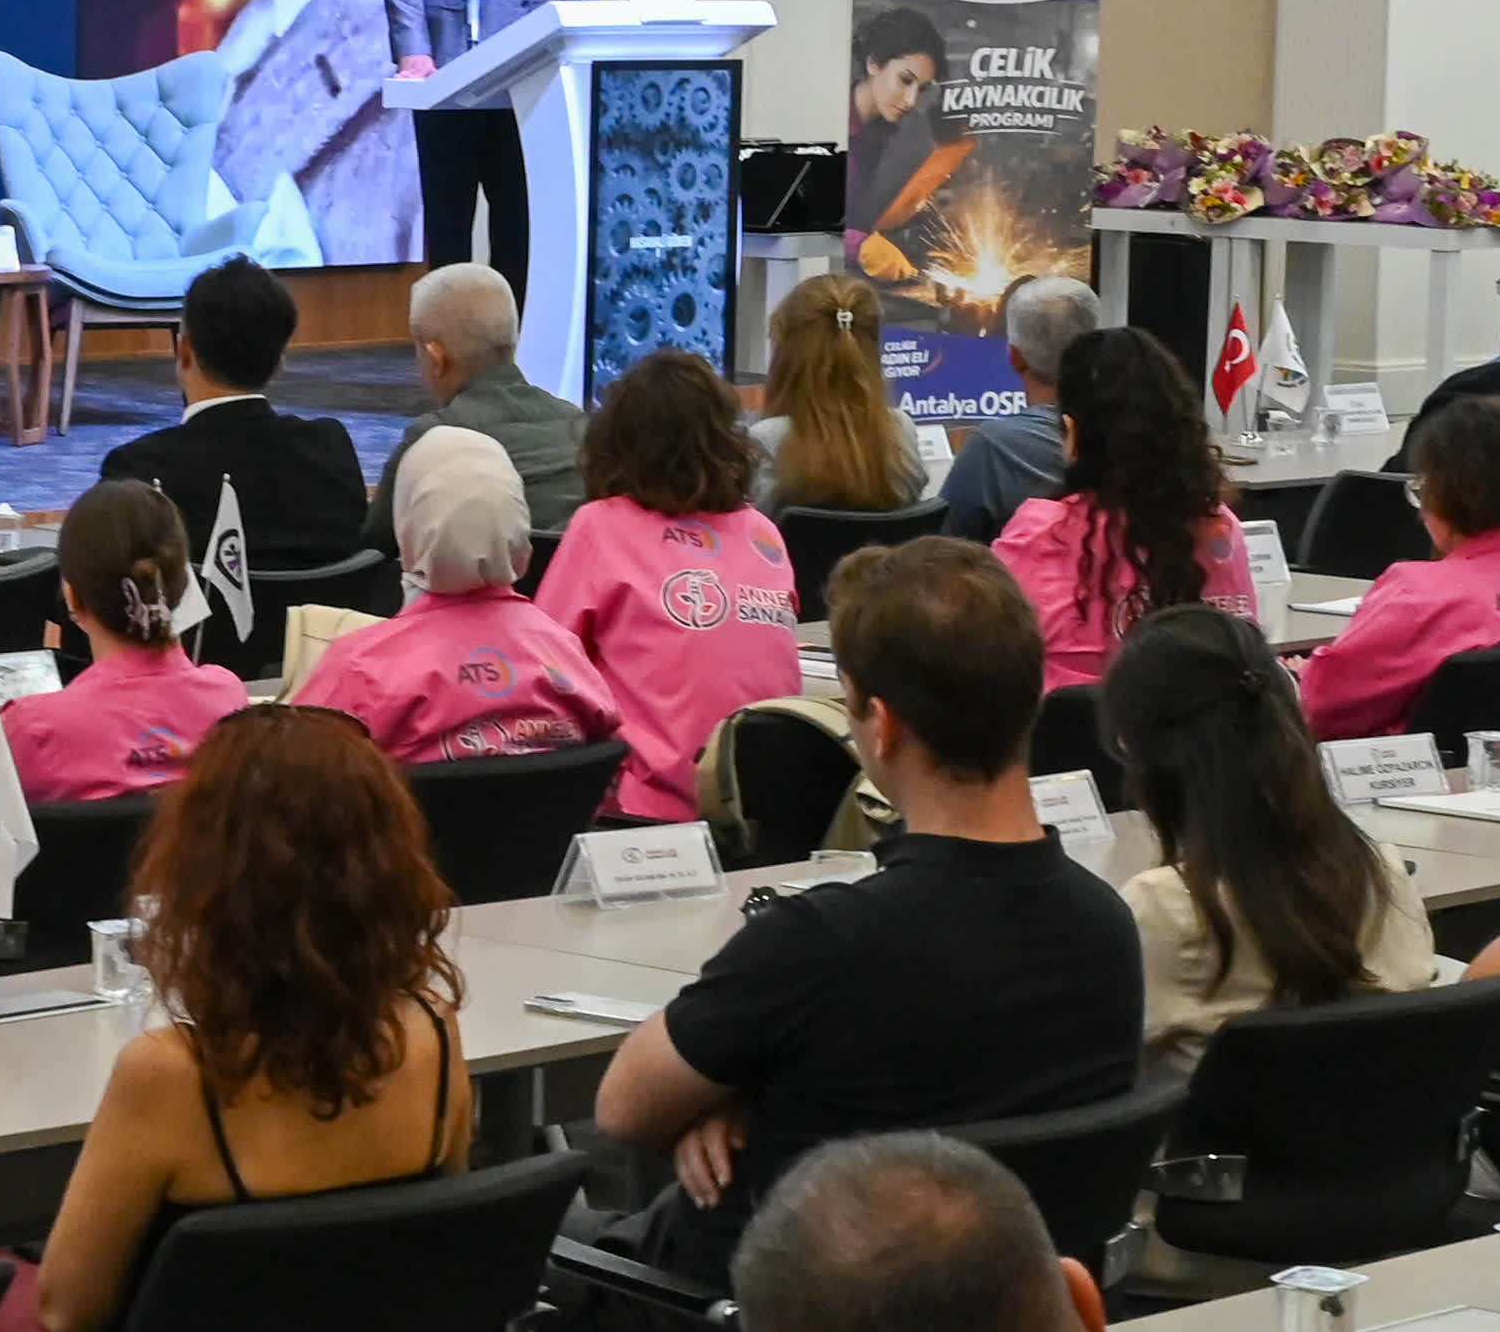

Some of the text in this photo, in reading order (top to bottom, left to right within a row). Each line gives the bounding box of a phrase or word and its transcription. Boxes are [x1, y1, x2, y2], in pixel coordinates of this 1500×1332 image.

[970, 46, 1056, 82] ÇELİK
[968, 112, 1054, 129] PROGRAMI
[899, 391, 978, 419] Antalya
